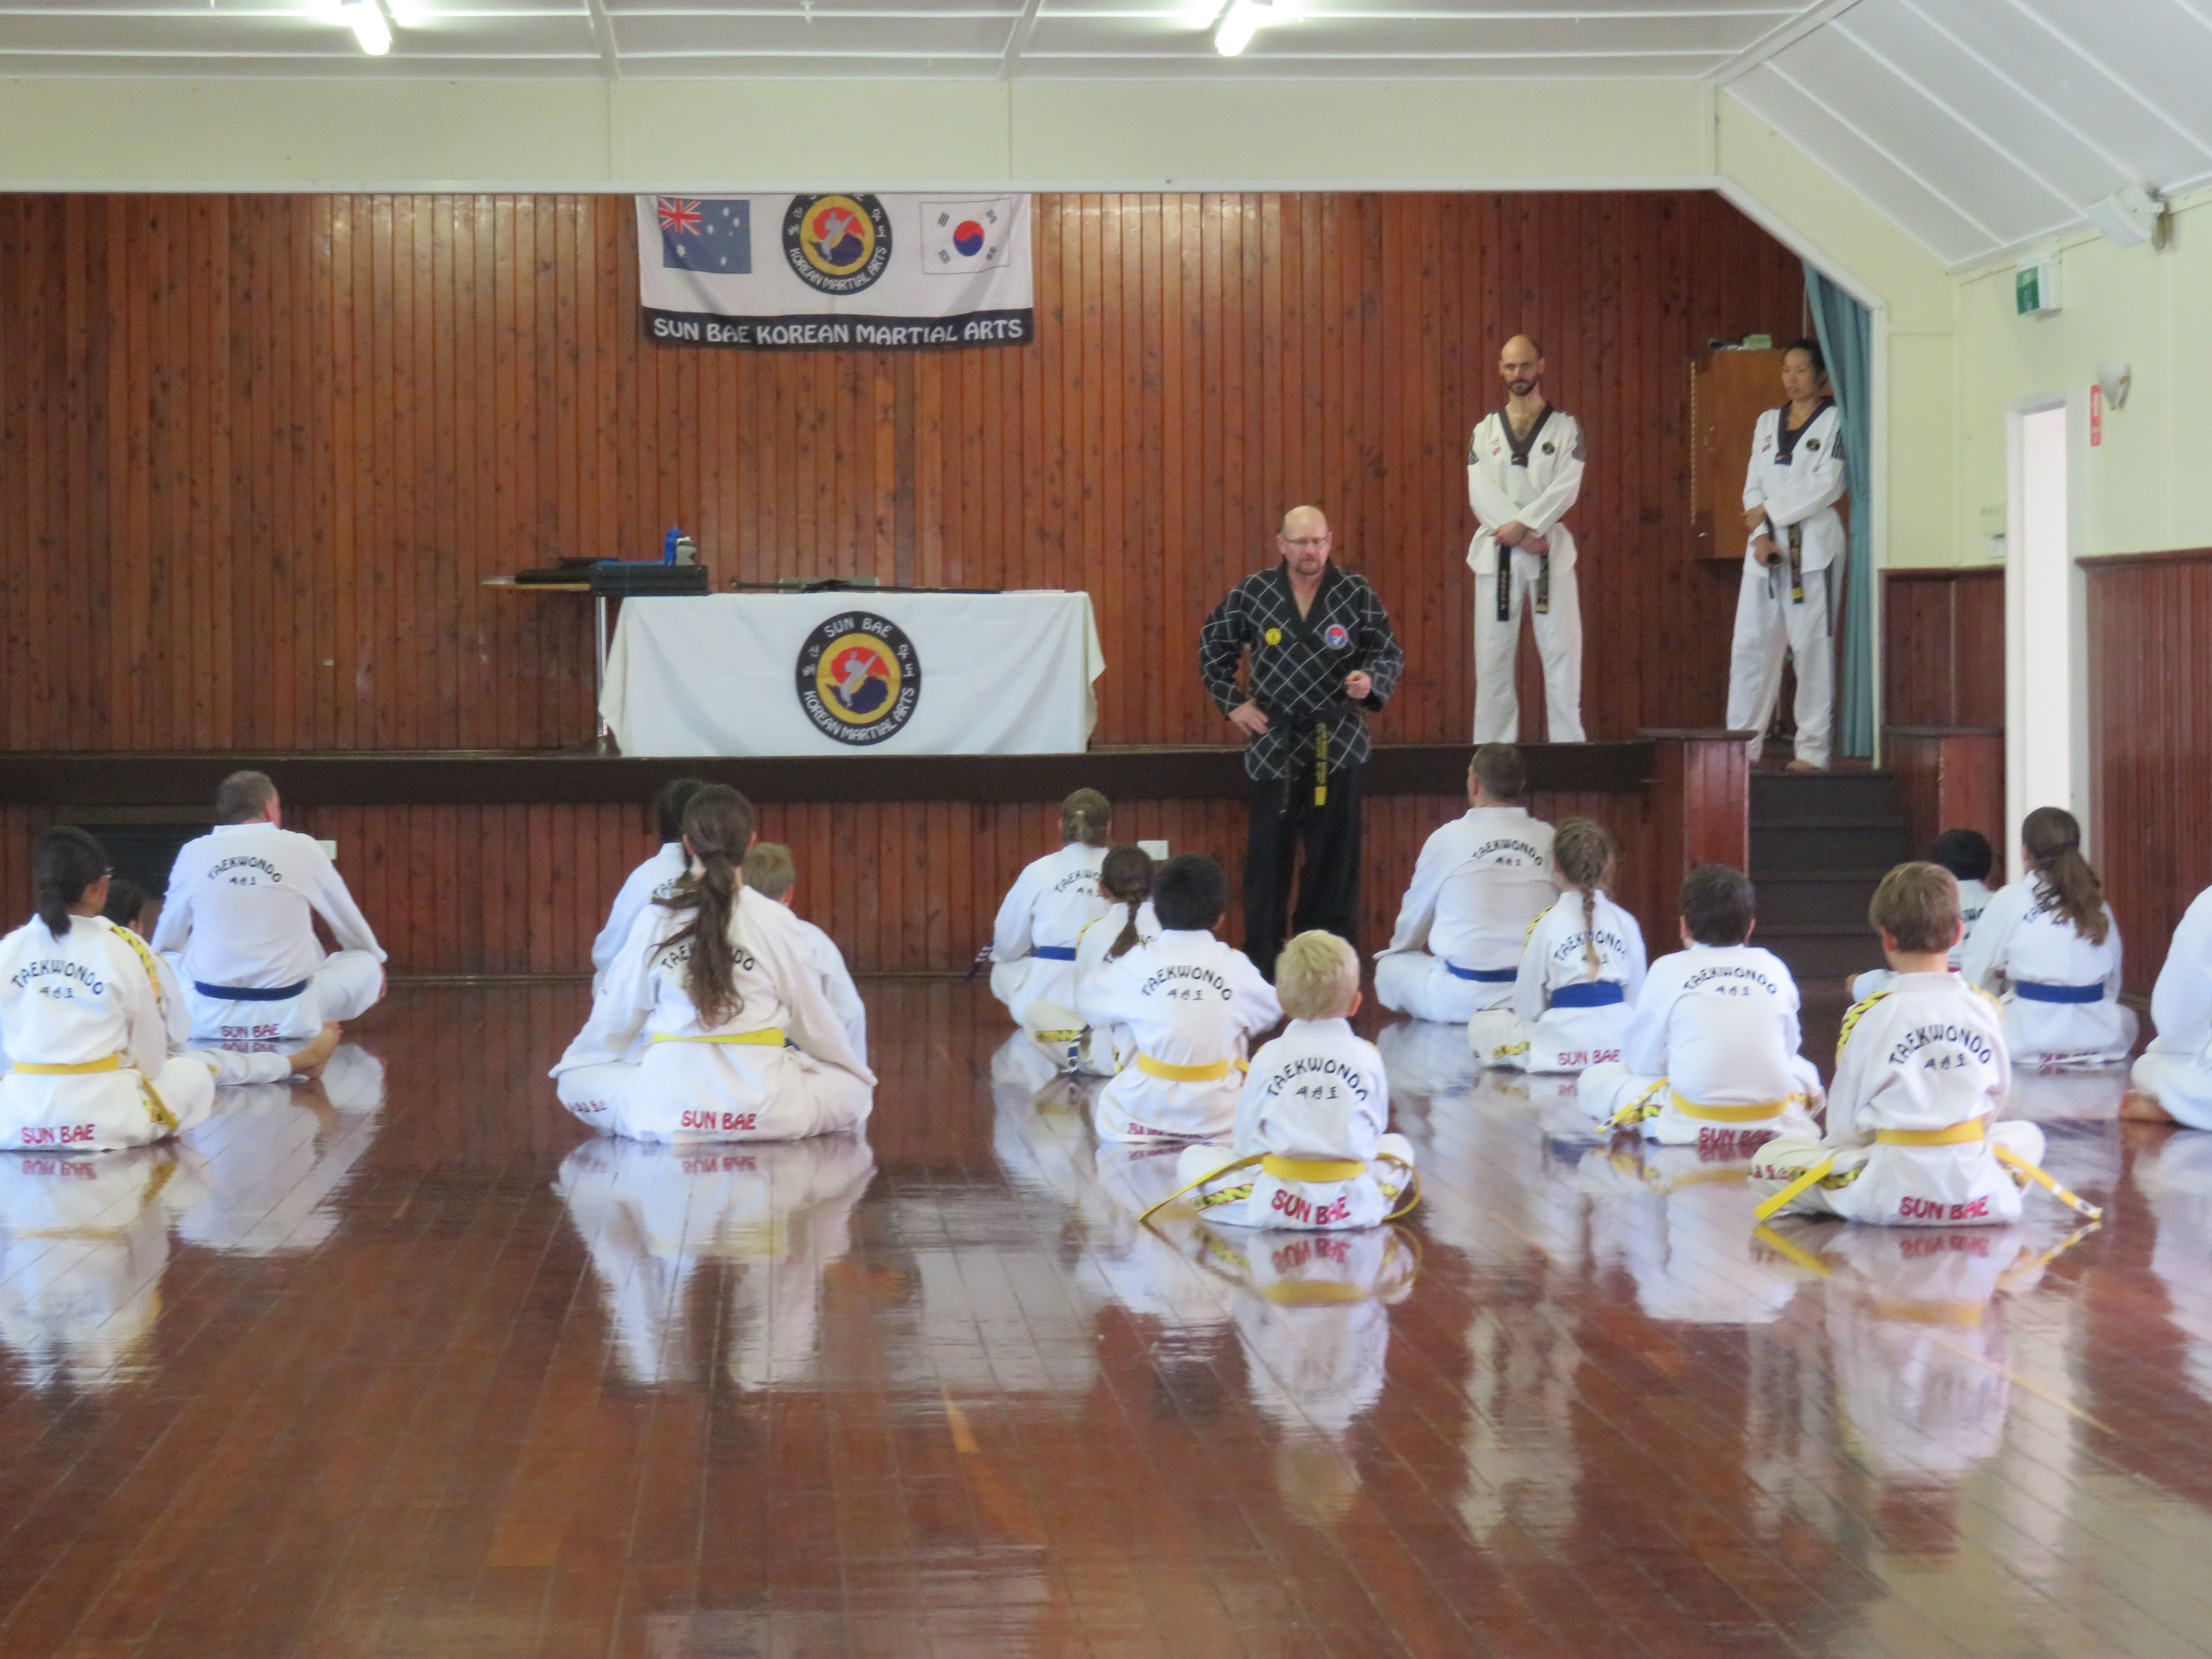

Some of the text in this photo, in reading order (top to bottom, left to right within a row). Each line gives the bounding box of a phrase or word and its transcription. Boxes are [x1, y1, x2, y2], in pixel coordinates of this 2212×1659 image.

[790, 247, 887, 291] KOREAN MARTIAL ARTS
[654, 318, 1023, 345] SUN BAE KOREAN MARTIAL ARTS
[824, 617, 893, 638] SUN BAE
[804, 687, 915, 741] KOREAN MARTIAL ARTS
[208, 856, 282, 883] TAEKWONDO
[11, 959, 105, 995] TAEKWONDO
[1141, 965, 1232, 1001] TAEKWONDO
[1683, 966, 1777, 994] TAEKWONDO
[221, 1023, 280, 1038] SUN BAE
[1558, 1049, 1622, 1065] SUN BAE
[1889, 1024, 1992, 1066] TAEKWONDO
[21, 1123, 95, 1144] SUN BAE
[681, 1110, 757, 1131] SUN BAE
[1699, 1127, 1736, 1144] SUN
[1271, 1189, 1351, 1225] SUN BAE
[1899, 1195, 1991, 1220] SUN BAE
